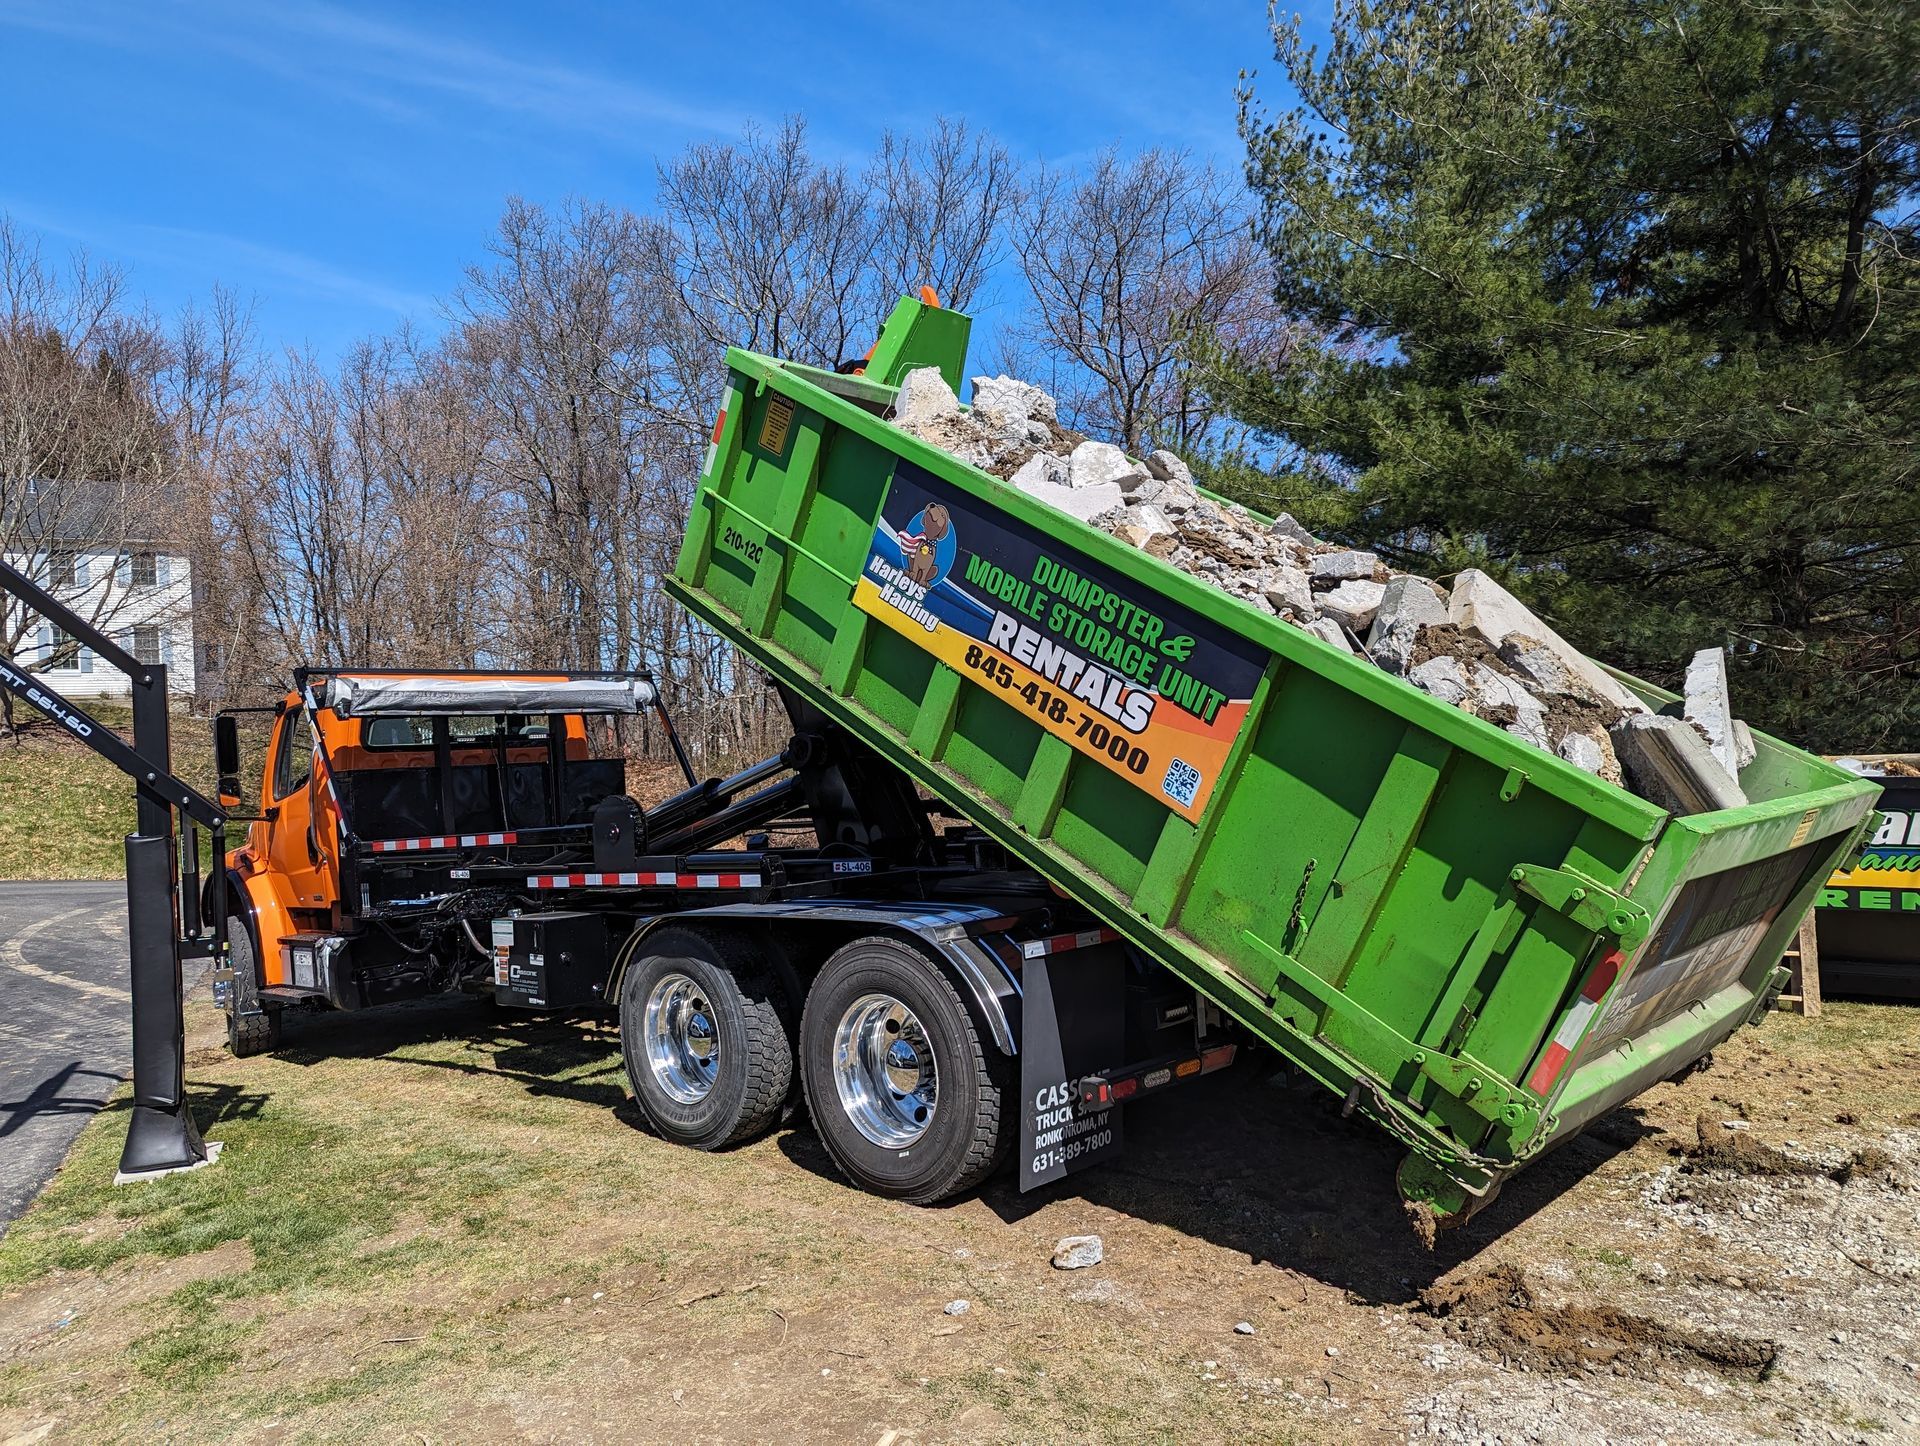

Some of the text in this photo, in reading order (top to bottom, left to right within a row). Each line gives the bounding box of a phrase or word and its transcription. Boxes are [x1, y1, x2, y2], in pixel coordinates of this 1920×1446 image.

[773, 392, 794, 408] CAUTION
[723, 526, 764, 565] 210-12C
[868, 555, 927, 601] Harleys
[879, 583, 940, 632] Hauling
[1031, 554, 1196, 662] DUMPSTER &
[965, 553, 1227, 723] MOBILE STORAGE UNIT
[987, 610, 1155, 733] RENTALS
[964, 644, 1150, 775] 845-418-7000
[841, 862, 871, 872] SL-406
[1035, 1105, 1074, 1131] TRUCK
[1035, 1111, 1109, 1150] RONKONKOMA, NY
[1032, 1128, 1112, 1173] 631-389-7800
